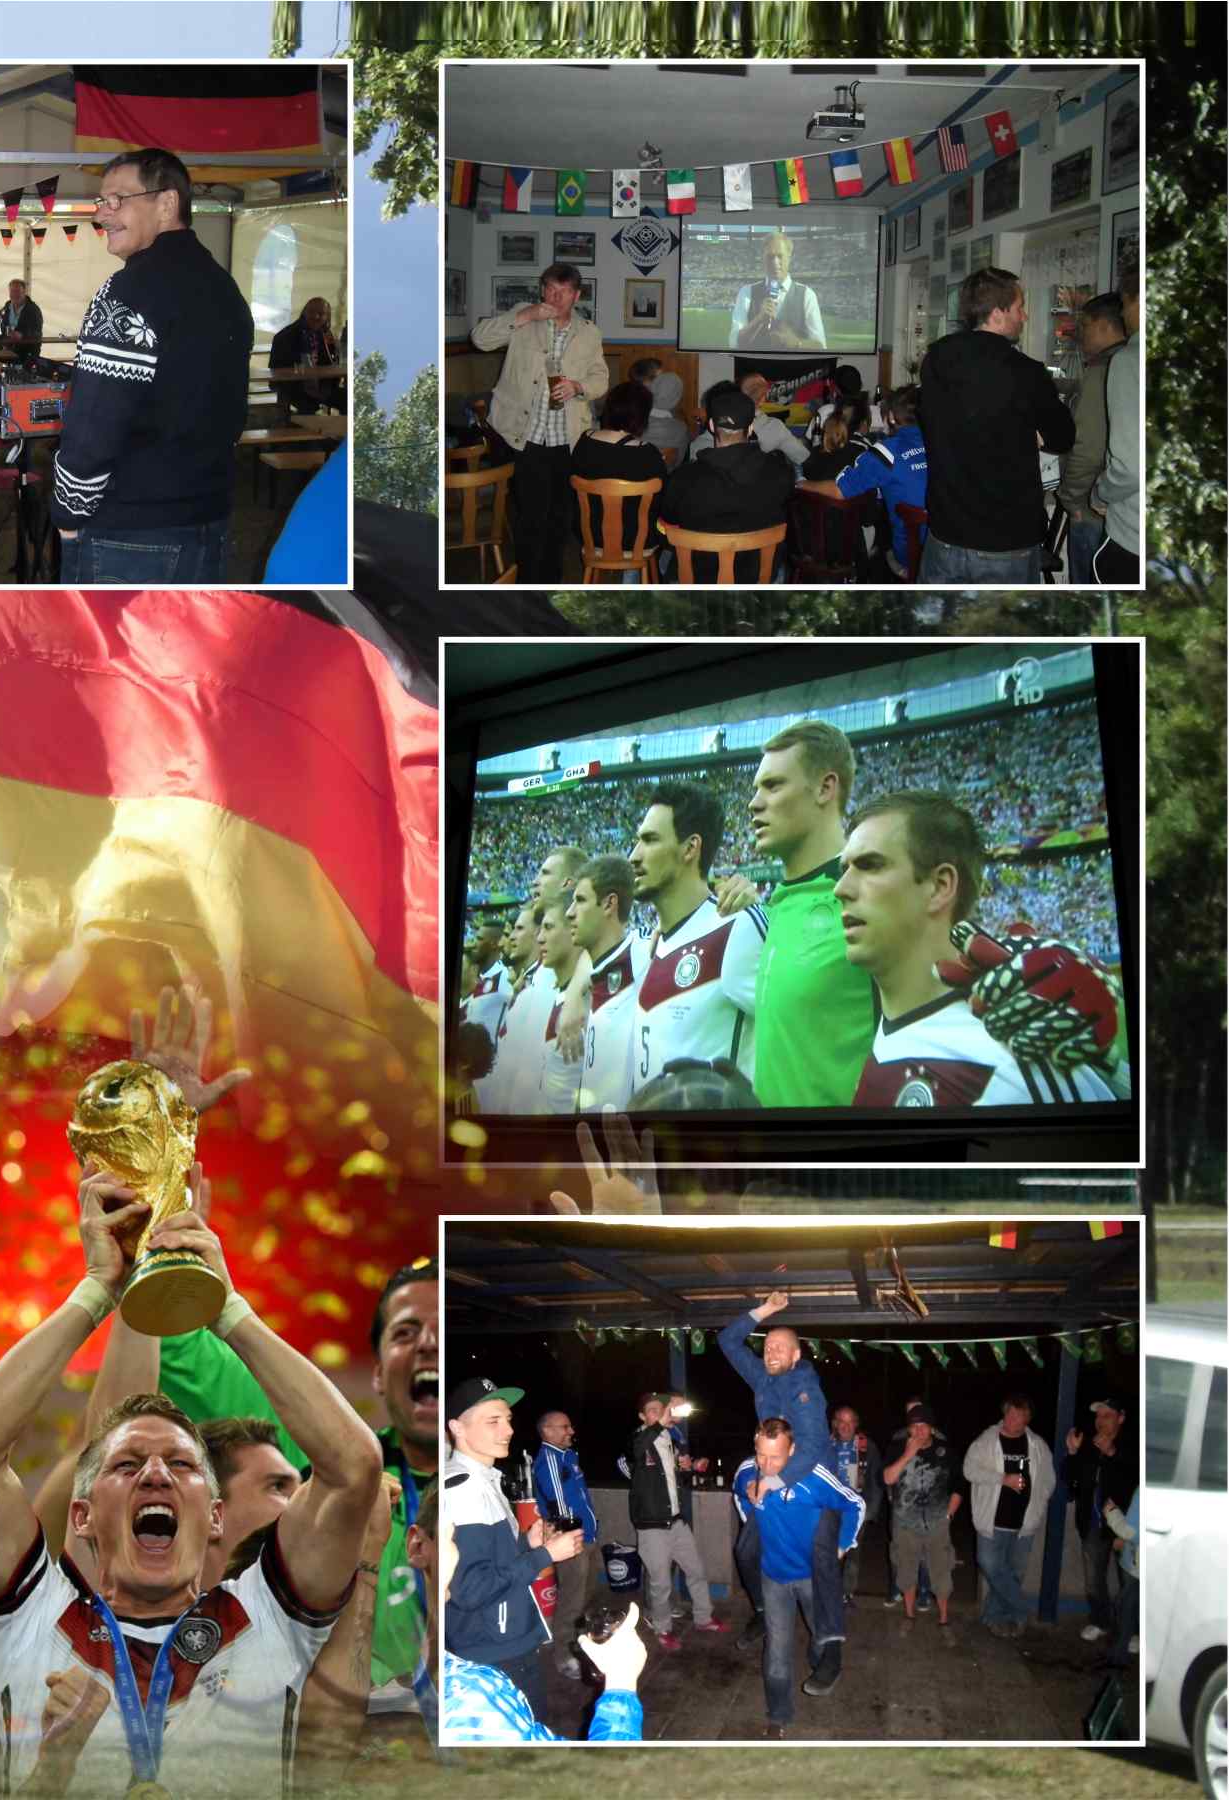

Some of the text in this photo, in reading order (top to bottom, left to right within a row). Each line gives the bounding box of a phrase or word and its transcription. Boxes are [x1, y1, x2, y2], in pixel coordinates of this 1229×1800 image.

[523, 767, 586, 788] GER GHA
[640, 1025, 651, 1079] 5
